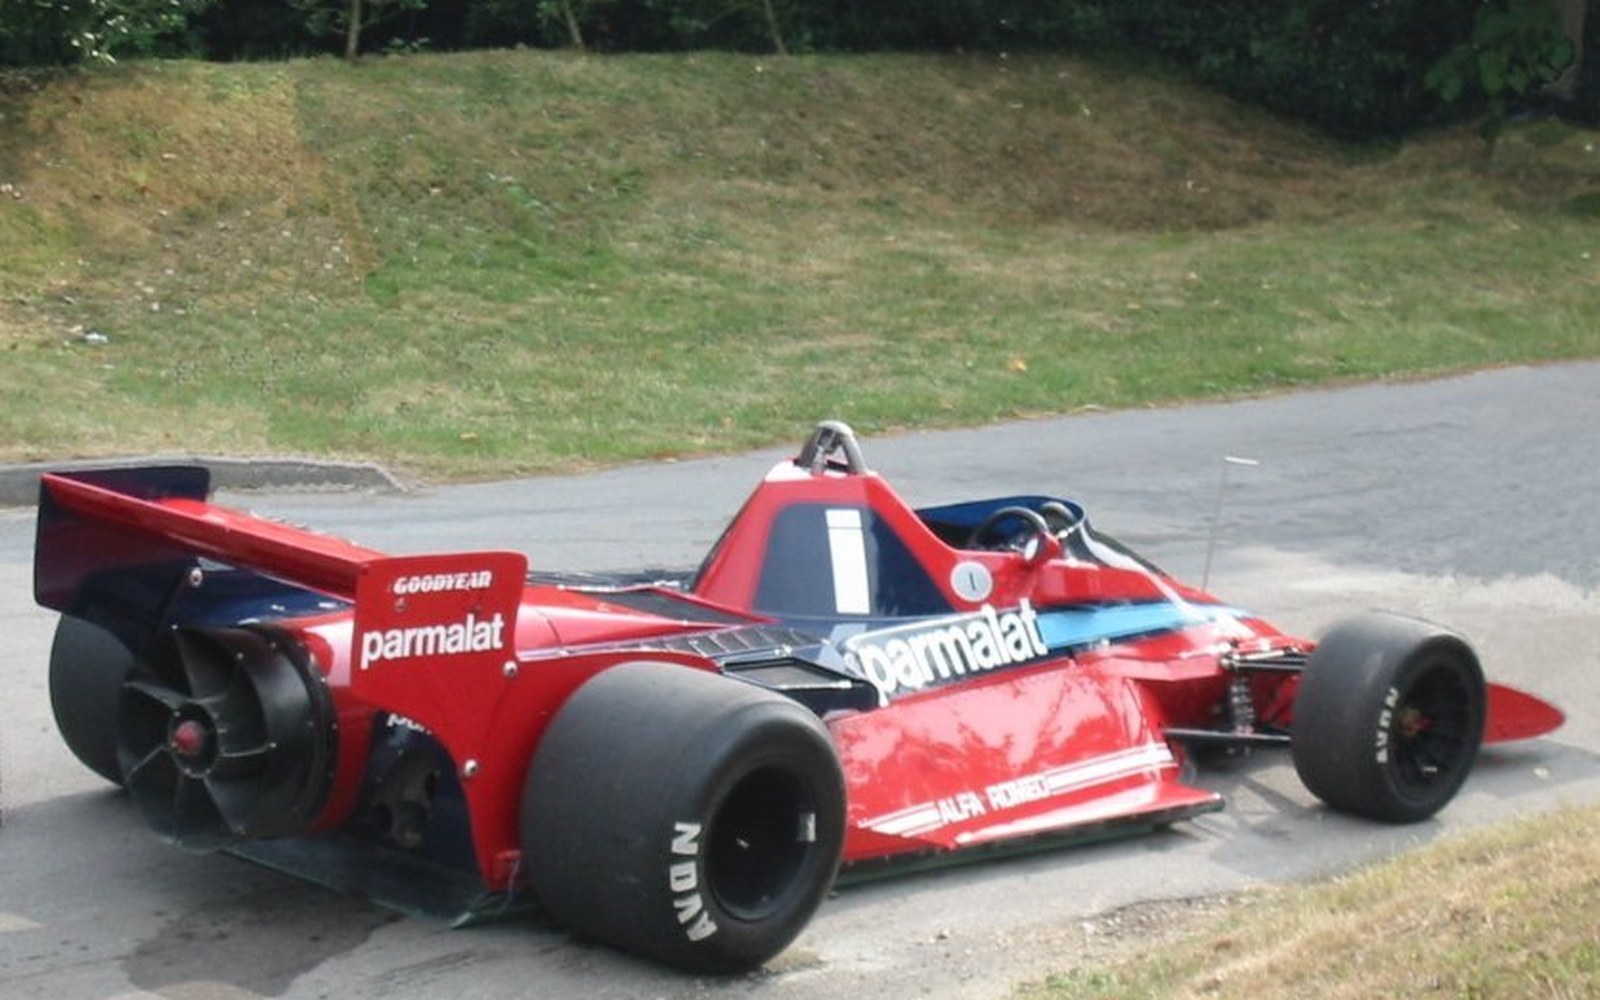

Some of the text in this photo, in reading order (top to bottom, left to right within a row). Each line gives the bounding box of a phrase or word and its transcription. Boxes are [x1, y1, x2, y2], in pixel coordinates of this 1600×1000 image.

[393, 570, 493, 595] GOODYEAR
[360, 612, 505, 670] parmalat
[855, 597, 1049, 708] parmalat
[938, 791, 986, 824] ALFA
[669, 821, 718, 941] AVON
